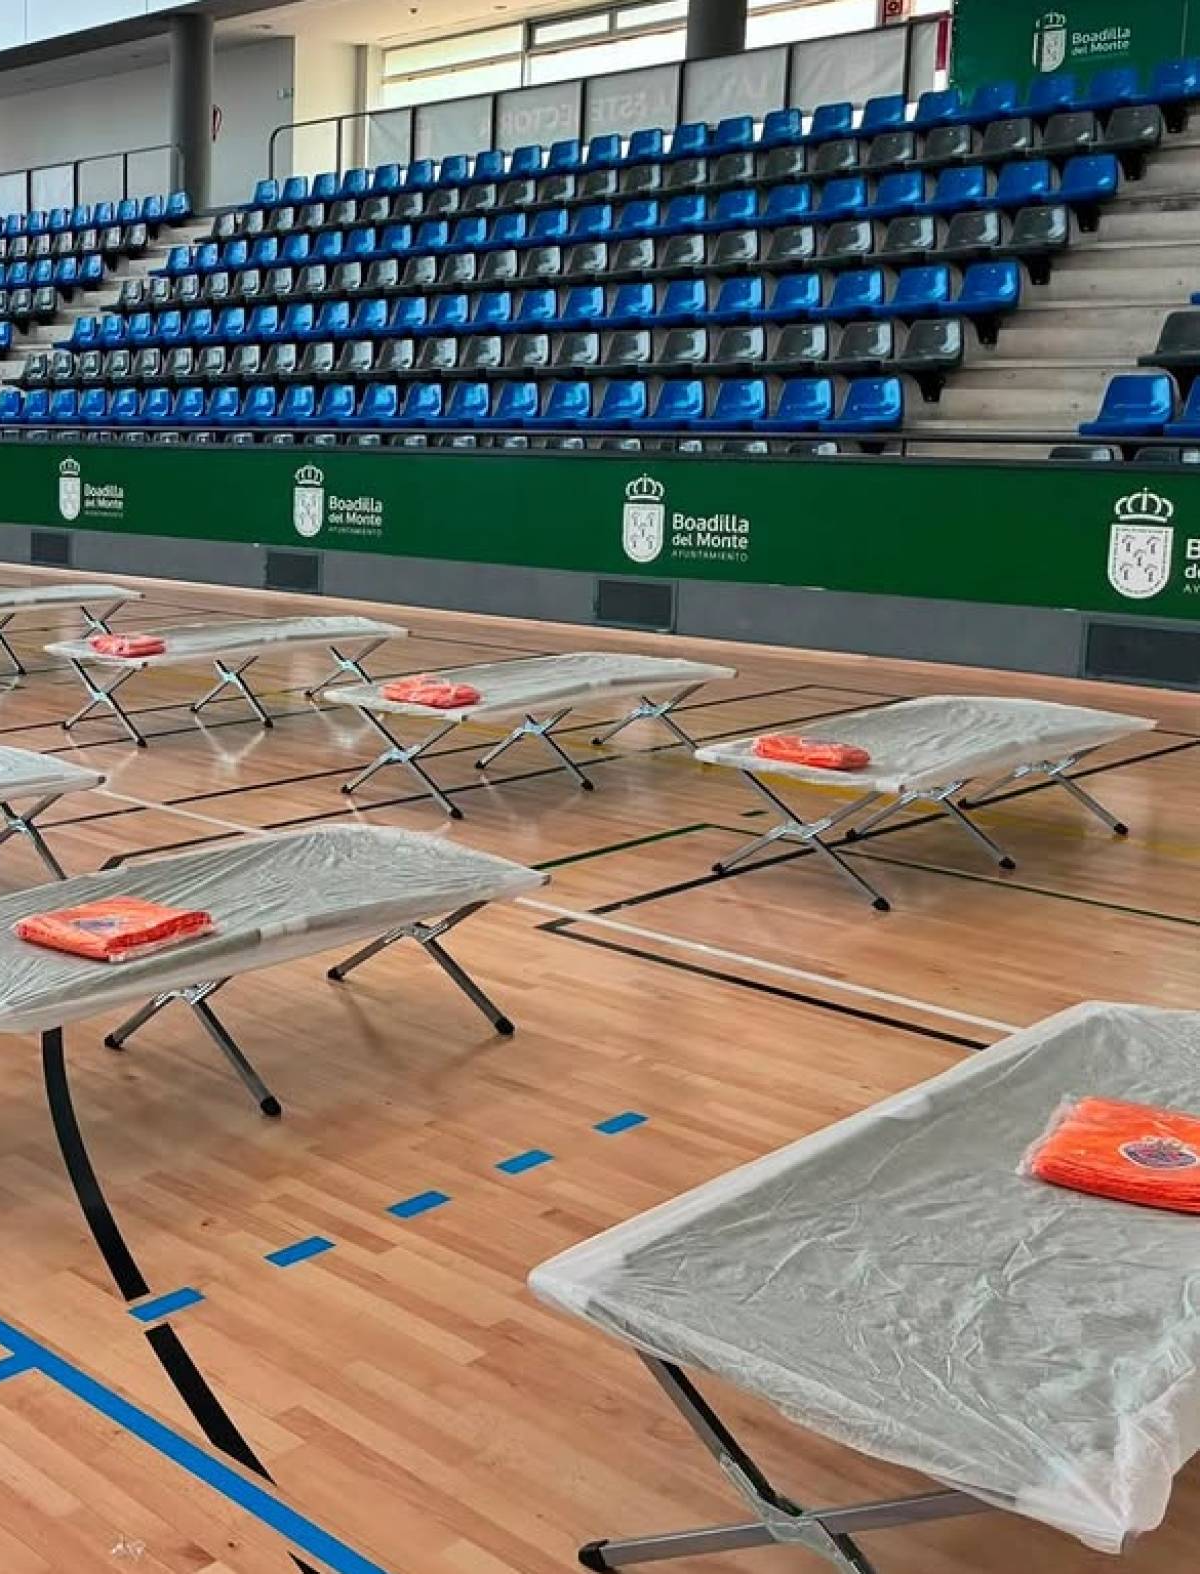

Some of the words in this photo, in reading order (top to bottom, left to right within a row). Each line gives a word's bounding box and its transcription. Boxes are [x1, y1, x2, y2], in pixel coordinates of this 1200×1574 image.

[1072, 27, 1130, 44] Boadilla
[83, 484, 123, 498] Boadilla
[329, 496, 382, 513] Boadilla
[345, 512, 382, 526] Monte
[672, 513, 749, 533] Boadilla
[672, 533, 692, 546] del
[697, 532, 749, 549] Monte
[671, 550, 749, 562] AYUNTAMIENTO
